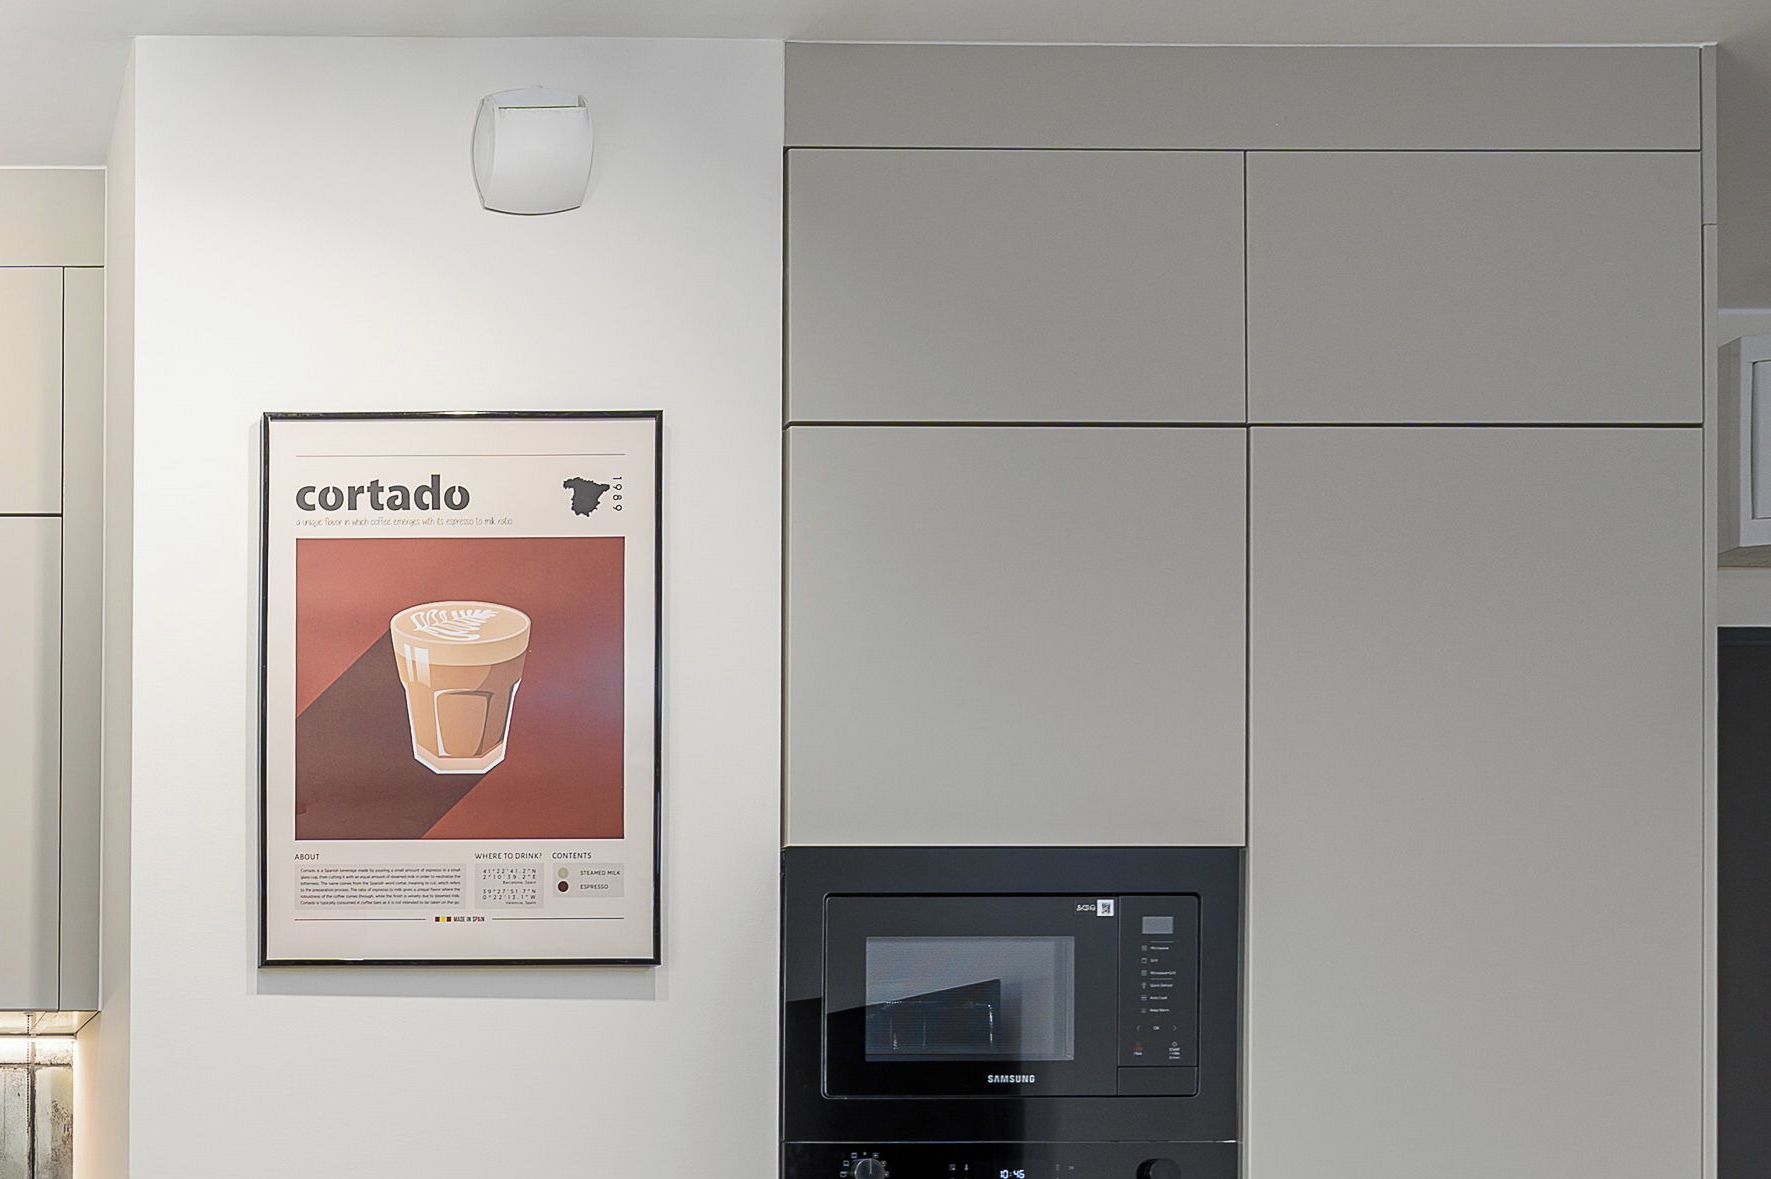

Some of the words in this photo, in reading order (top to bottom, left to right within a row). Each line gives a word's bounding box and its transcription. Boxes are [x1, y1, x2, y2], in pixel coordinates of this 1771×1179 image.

[296, 474, 470, 511] cortado
[613, 476, 623, 511] 1989
[987, 1074, 1035, 1083] SAMSUNG
